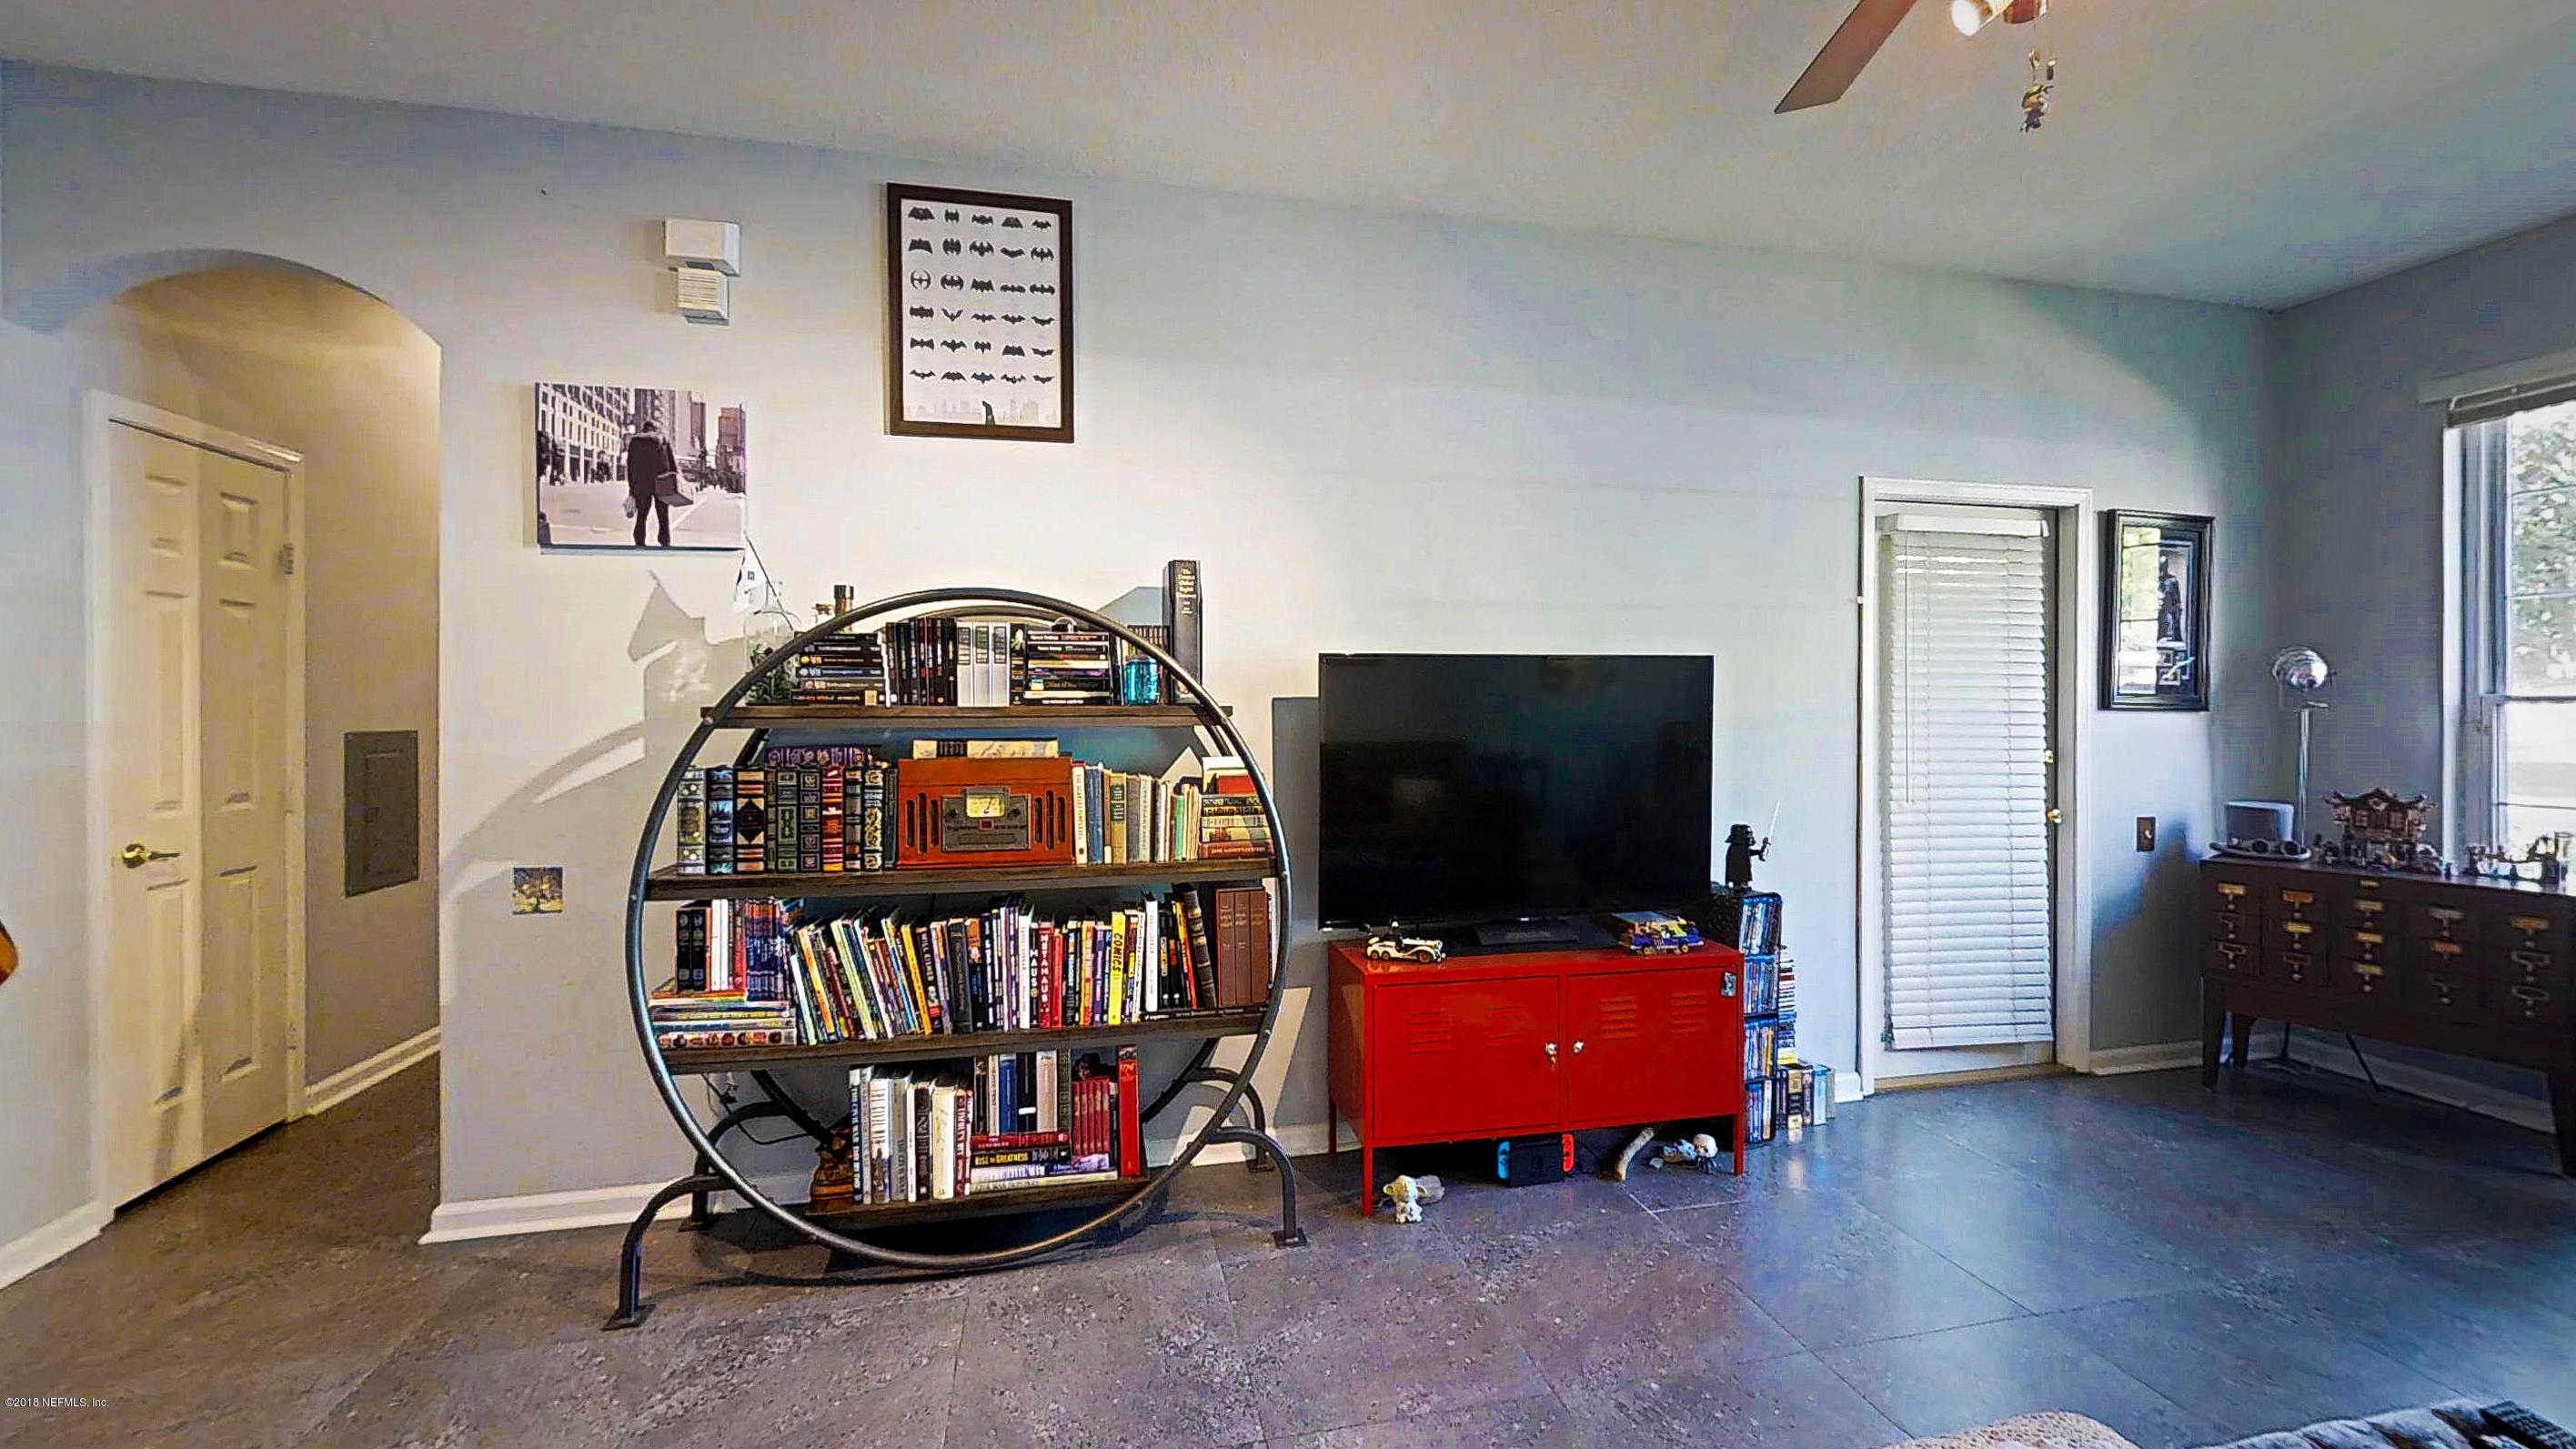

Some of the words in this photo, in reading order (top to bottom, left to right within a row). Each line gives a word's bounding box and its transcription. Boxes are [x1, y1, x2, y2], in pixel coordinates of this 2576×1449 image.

[1030, 949, 1039, 987] MAUS
[1041, 934, 1049, 1002] METAMAUS
[1112, 932, 1123, 972] COMICS
[974, 1155, 989, 1165] RISE
[996, 1152, 1029, 1163] GREATNESS
